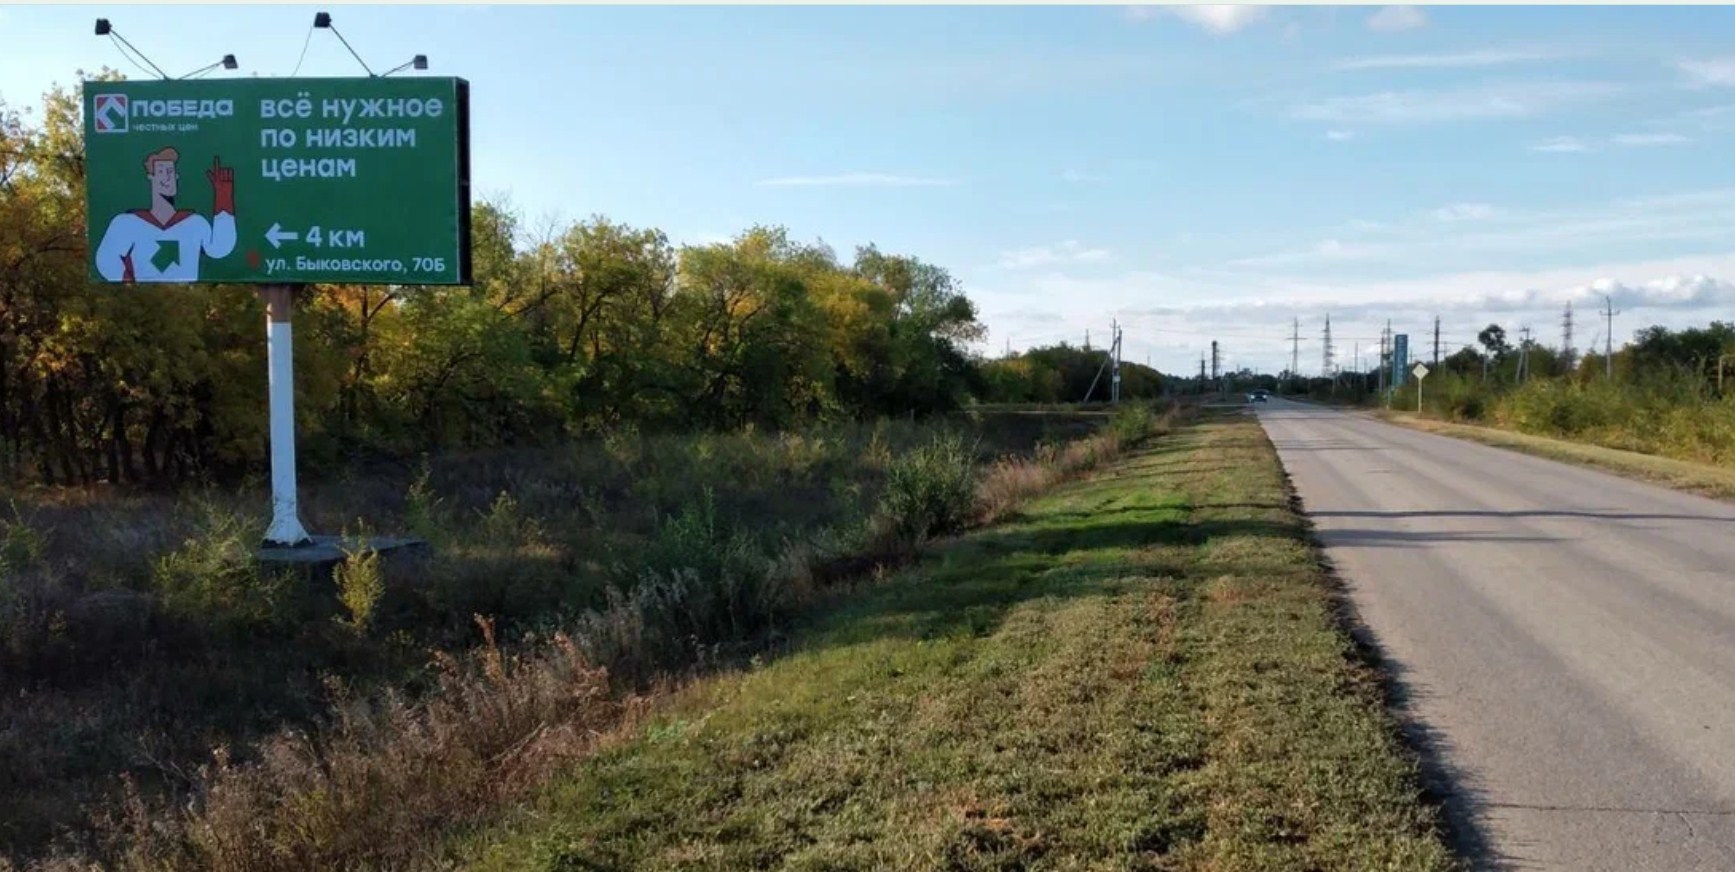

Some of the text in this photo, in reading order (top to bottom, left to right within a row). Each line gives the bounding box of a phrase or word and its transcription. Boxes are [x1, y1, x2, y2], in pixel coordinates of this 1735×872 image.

[260, 92, 443, 125] всё нужное
[260, 128, 416, 148] по низким
[262, 158, 356, 181] ценам
[306, 225, 365, 248] 4 км
[265, 256, 446, 274] ул. Быковского, 70Б
